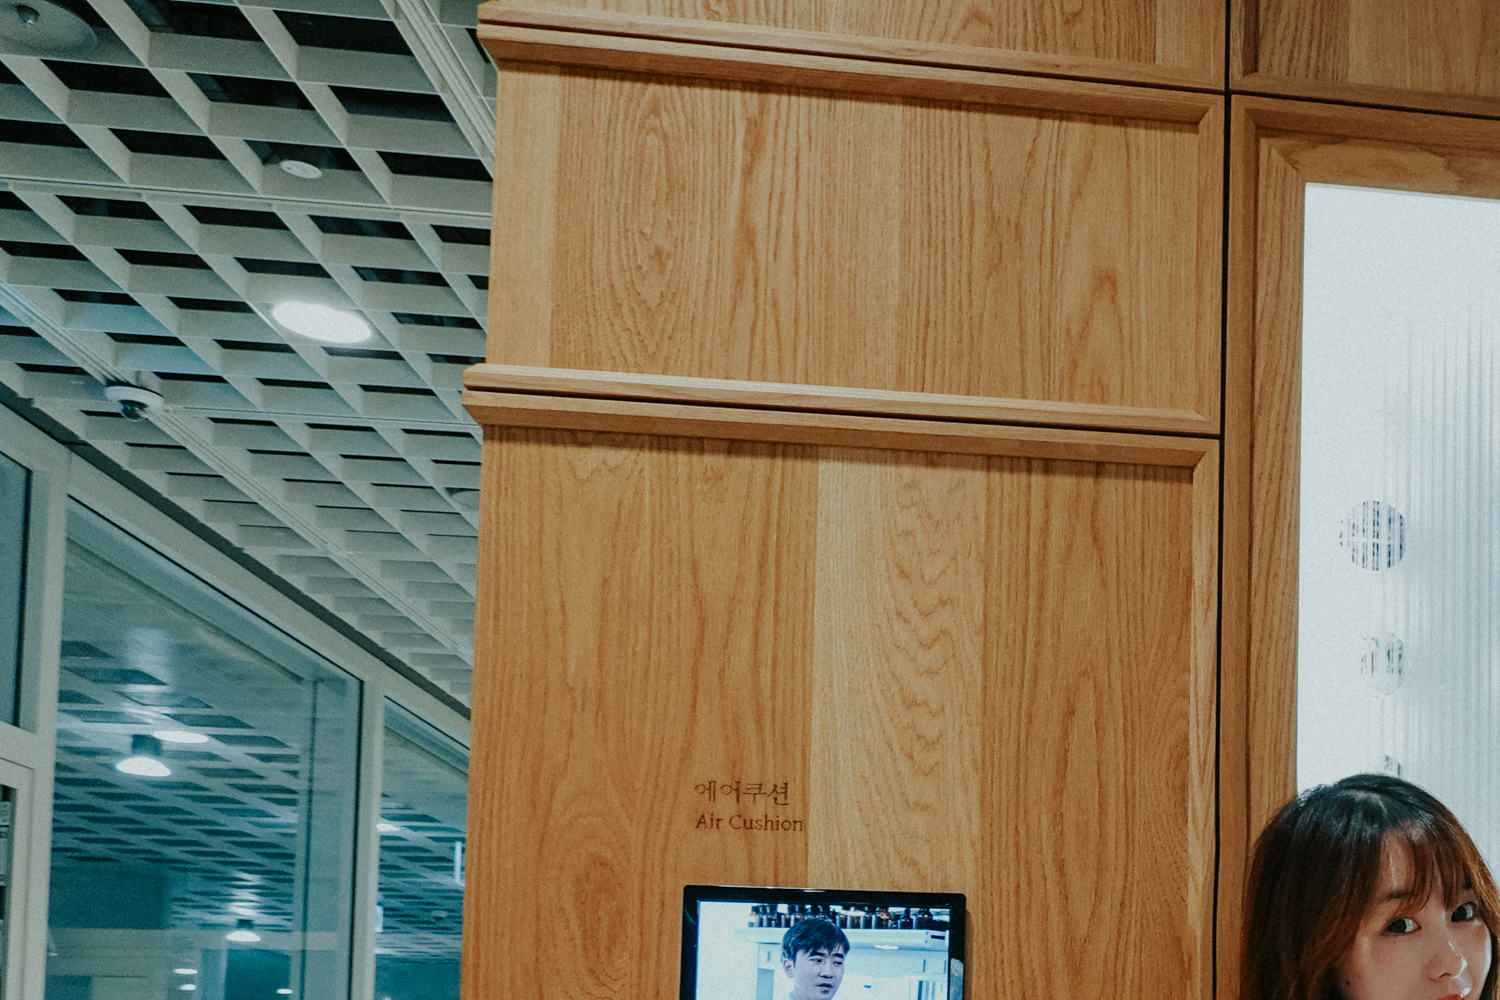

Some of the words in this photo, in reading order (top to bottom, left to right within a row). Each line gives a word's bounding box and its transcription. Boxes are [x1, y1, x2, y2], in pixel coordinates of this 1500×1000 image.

[695, 780, 789, 806] 에어쿠션
[695, 814, 723, 829] Air
[729, 814, 803, 832] Cushion
